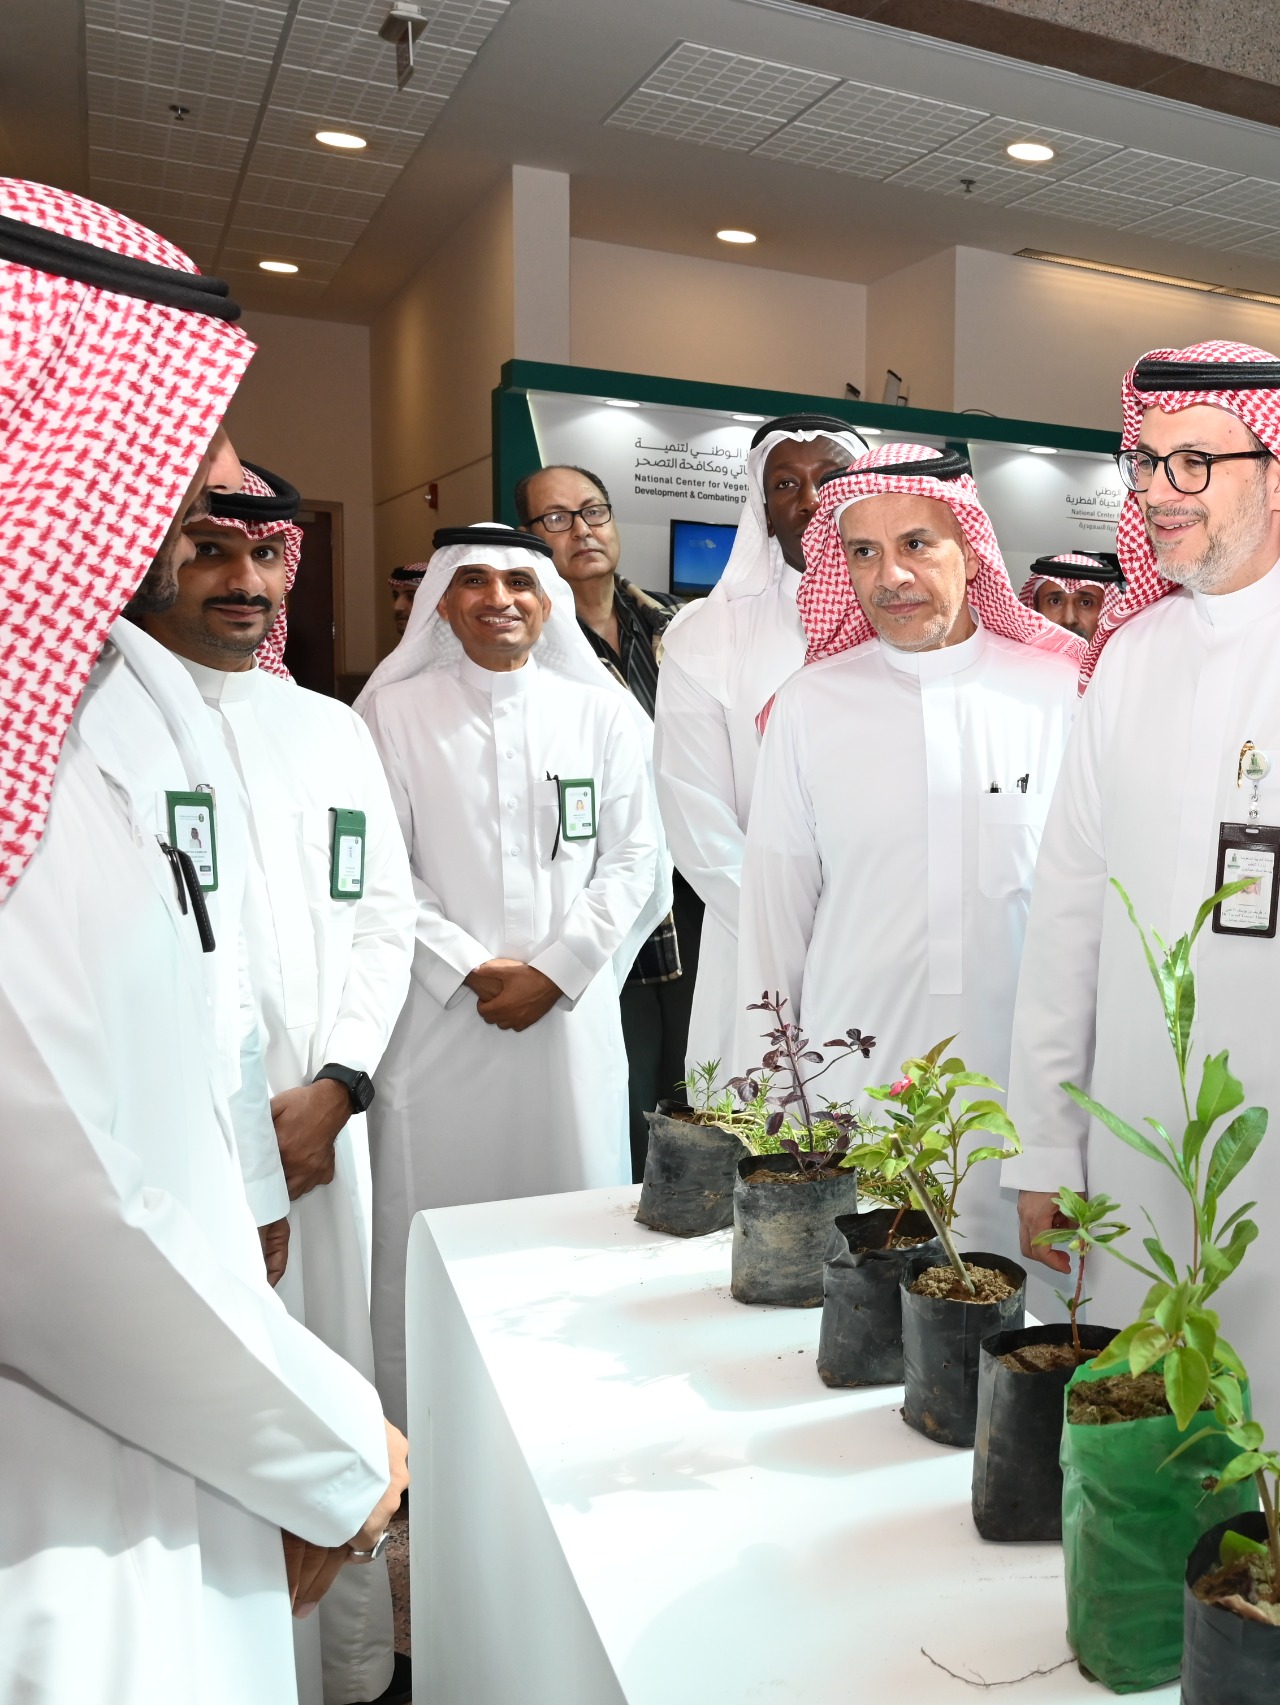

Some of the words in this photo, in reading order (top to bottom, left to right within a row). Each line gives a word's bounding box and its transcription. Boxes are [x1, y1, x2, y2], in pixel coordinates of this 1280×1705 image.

[634, 437, 689, 454] لتنمية
[634, 457, 678, 468] التصحر
[679, 458, 728, 476] ومكافحة
[730, 464, 748, 480] اتي
[634, 473, 673, 485] National
[676, 477, 706, 487] Center
[708, 480, 721, 489] for
[634, 486, 688, 498] Development
[689, 491, 696, 499] &
[697, 491, 740, 504] Combating
[1071, 508, 1095, 516] National
